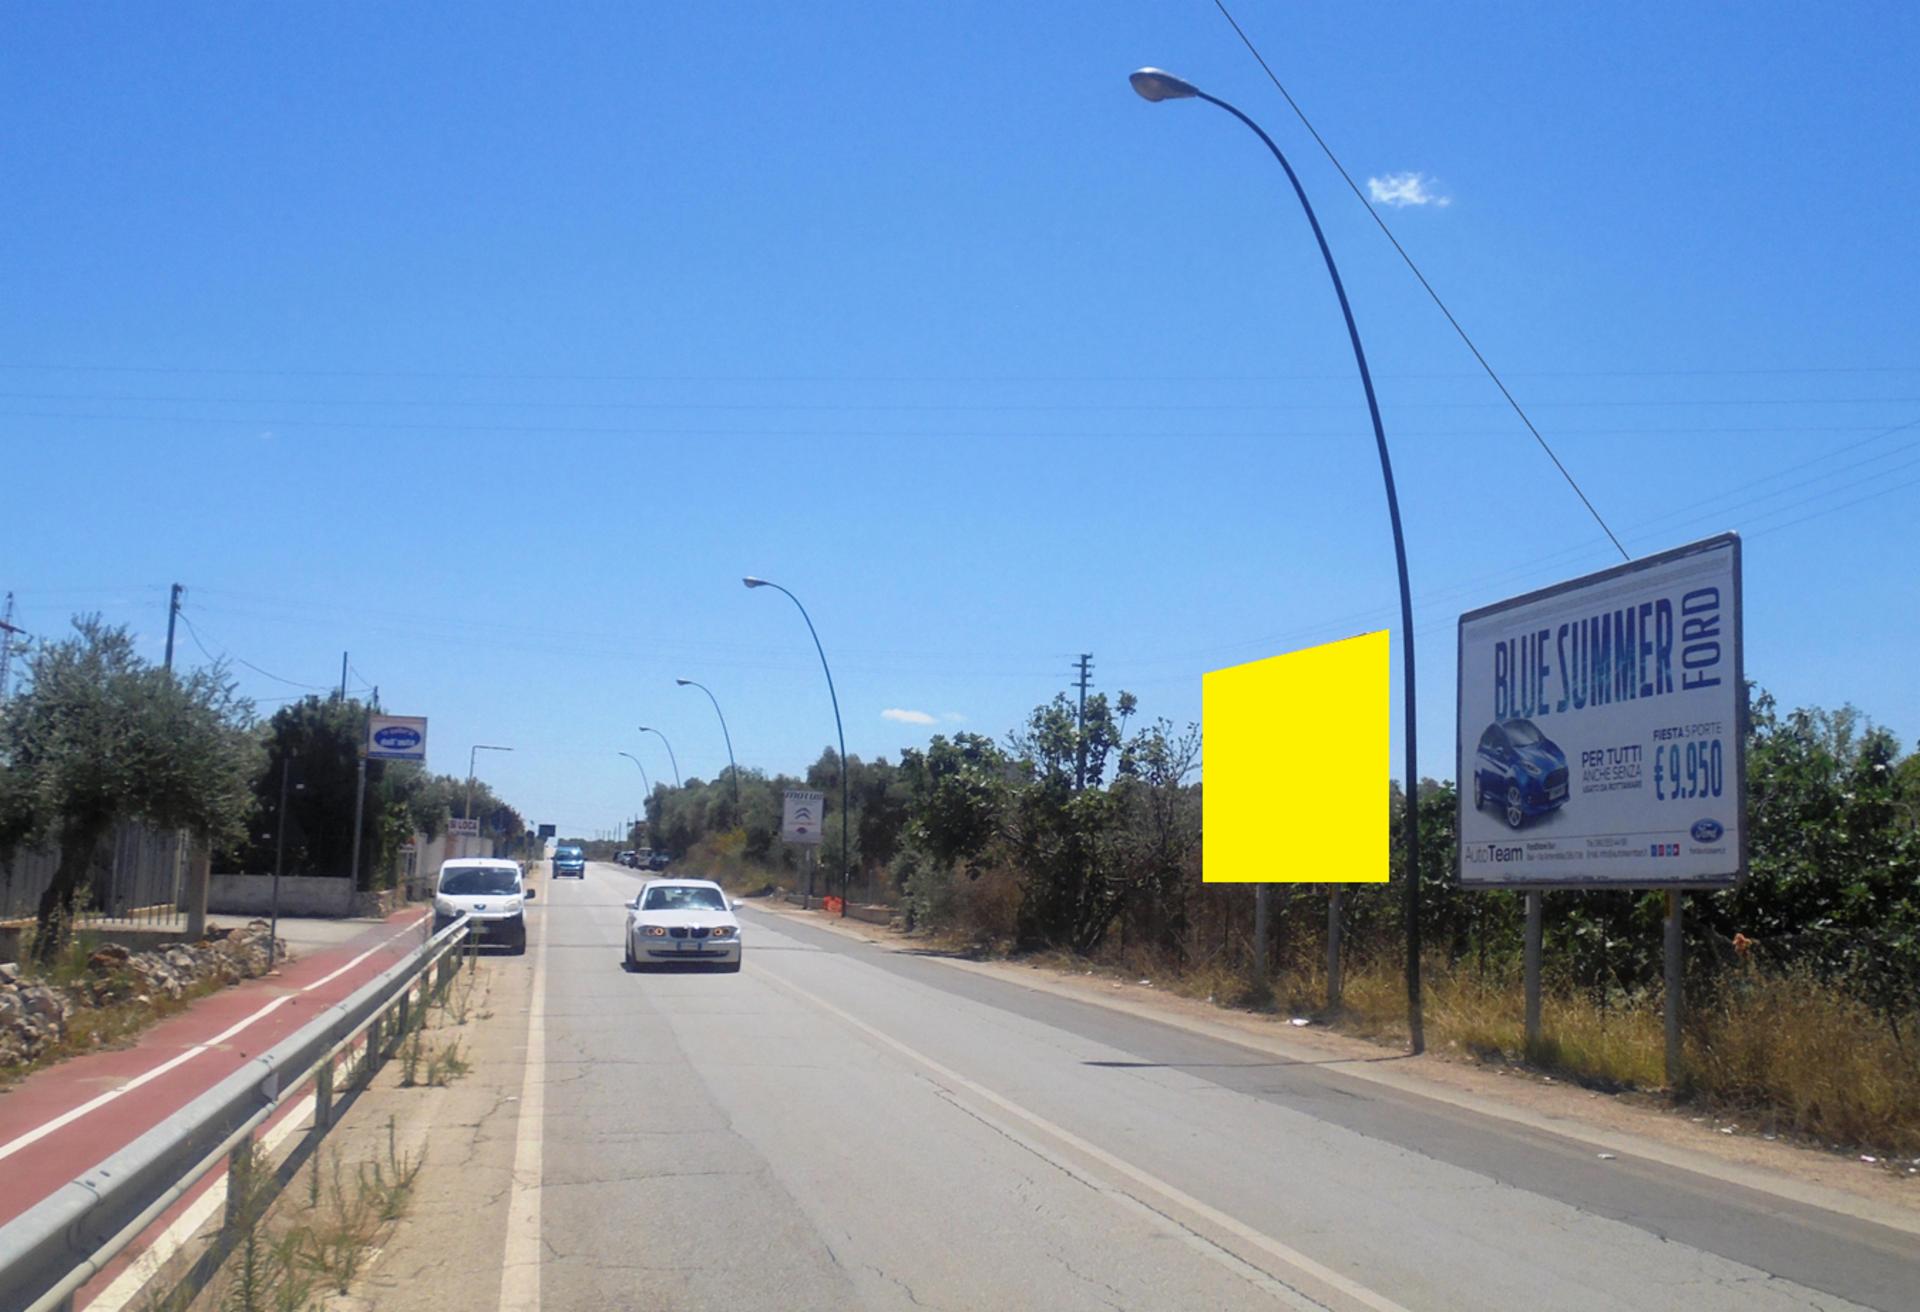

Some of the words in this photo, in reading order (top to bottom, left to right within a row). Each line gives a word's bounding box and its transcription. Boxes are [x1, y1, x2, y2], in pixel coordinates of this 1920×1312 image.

[1682, 586, 1721, 691] FORD
[1495, 629, 1550, 720] BLUE
[1556, 597, 1673, 713] SUMMER
[1653, 727, 1684, 742] FIESTA
[1582, 750, 1604, 768] PER
[1606, 744, 1642, 765] TUTTI
[1583, 767, 1612, 782] ANCHE
[1612, 764, 1642, 780] SENZA
